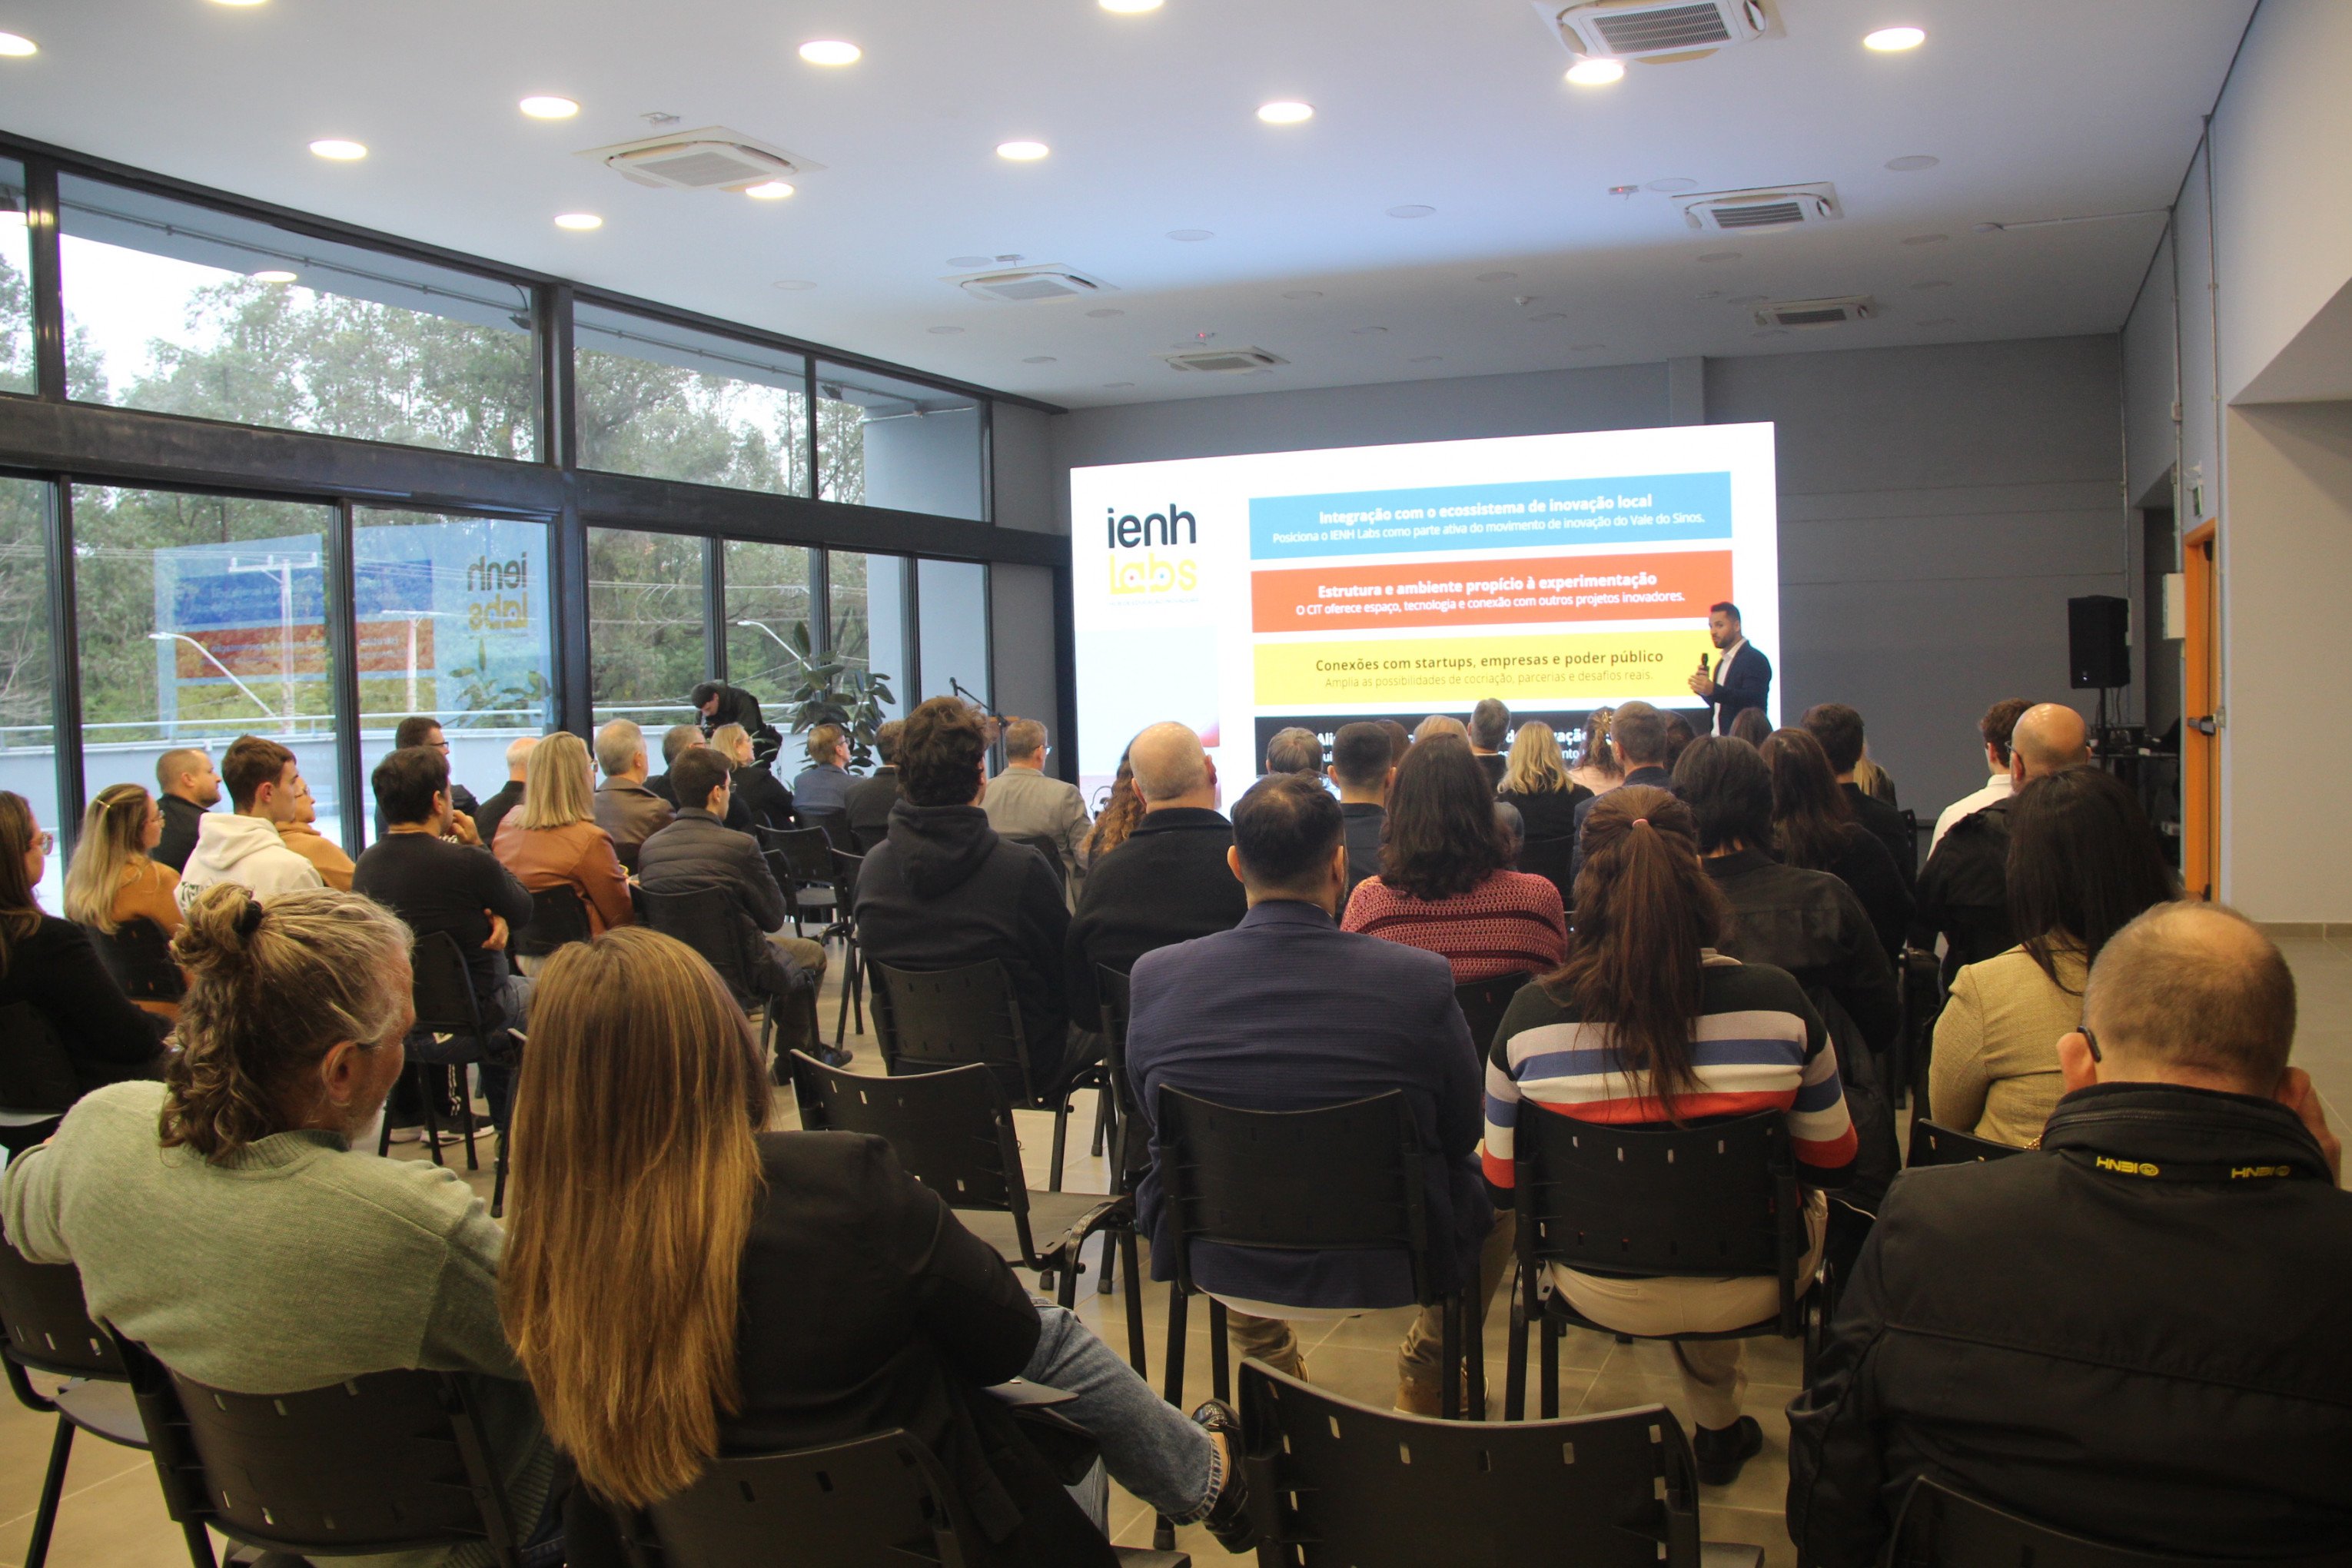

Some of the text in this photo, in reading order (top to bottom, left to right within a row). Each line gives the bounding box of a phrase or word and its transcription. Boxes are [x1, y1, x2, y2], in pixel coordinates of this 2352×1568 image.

[1320, 493, 1652, 526] Integração com o ecossistema de inovação local
[1108, 503, 1197, 548] ienh
[1273, 513, 1705, 543] Posiciona o IENH Labs como parte ativa do movimento de inovação do Vale do Sinos.
[1318, 572, 1657, 598] Estrutura e ambiente propício à experimentação
[1296, 591, 1685, 615] O CIT oferece espaço, tecnologia e conexão com outros projetos inovadores.
[1315, 649, 1663, 672] Conexões com startups, empresas e poder público
[1324, 669, 1653, 689] Amplia as possibilidades de cocriação, parcerias e desafios reais.
